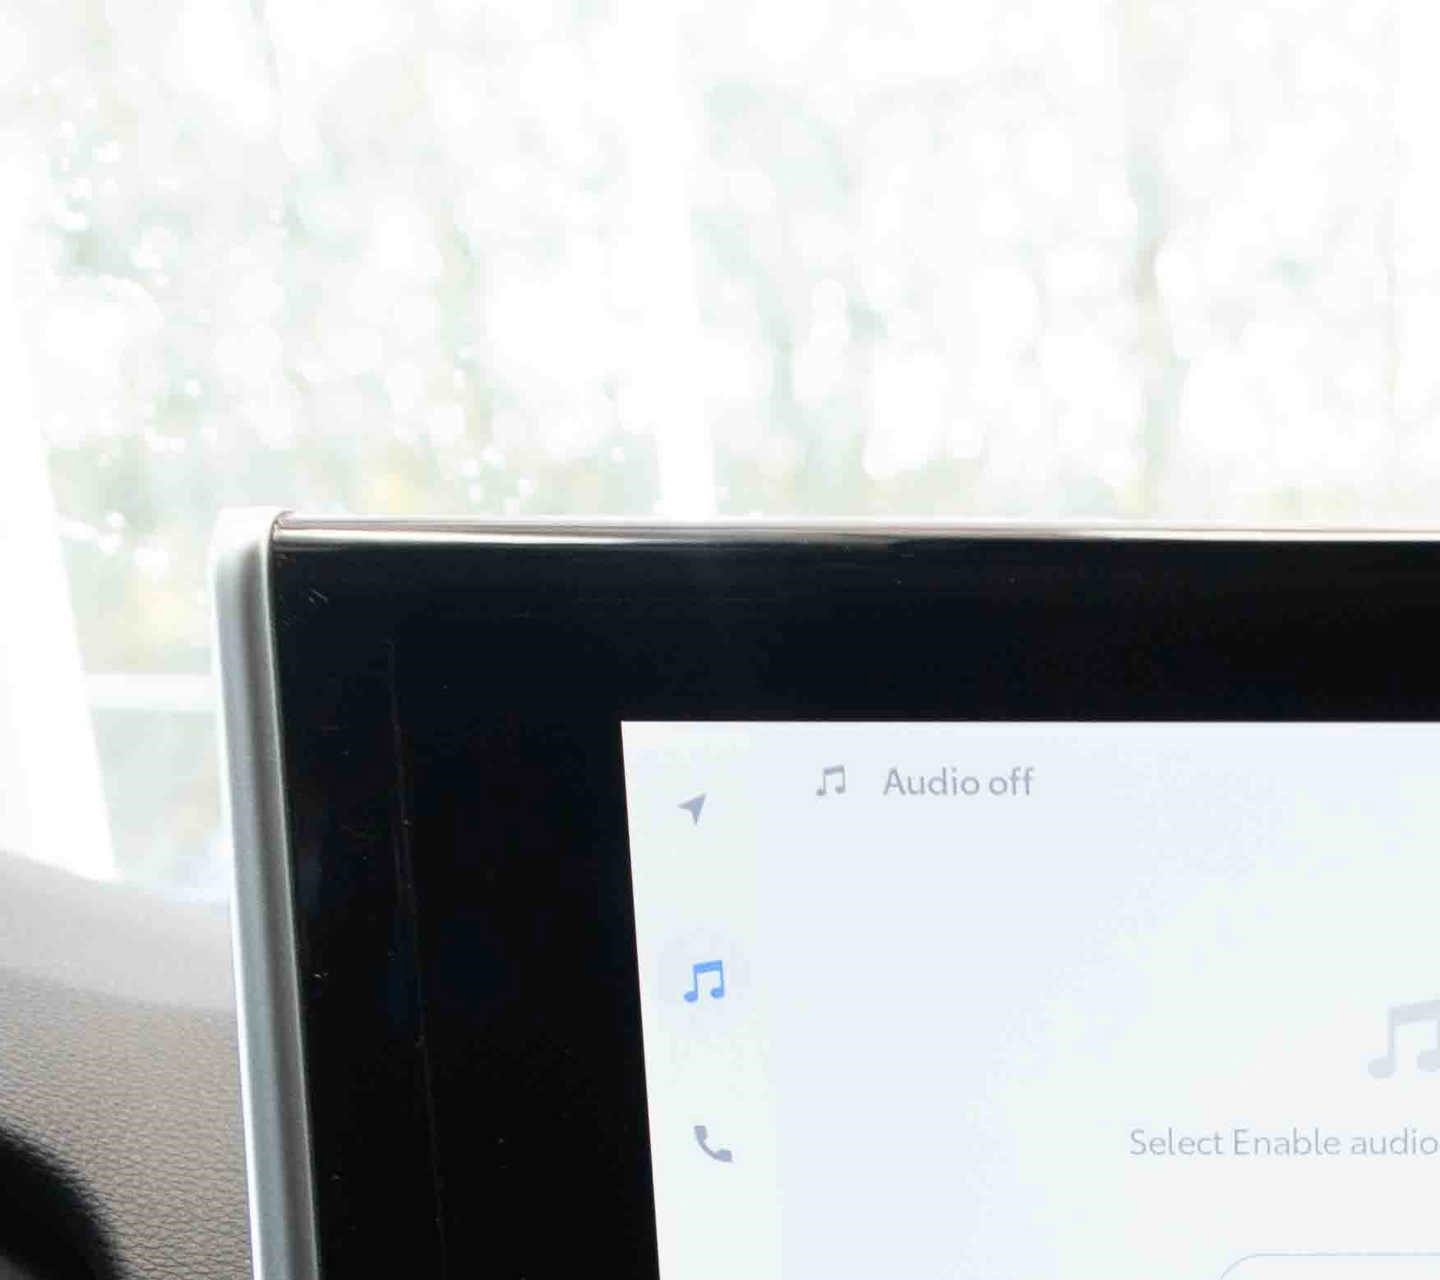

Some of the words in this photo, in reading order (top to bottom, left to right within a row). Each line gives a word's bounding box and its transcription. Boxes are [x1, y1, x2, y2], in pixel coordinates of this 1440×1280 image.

[882, 766, 980, 797] Audio
[989, 765, 1036, 797] off
[1129, 1128, 1224, 1157] Select
[1233, 1128, 1341, 1157] Enable
[1351, 1128, 1439, 1157] audio
